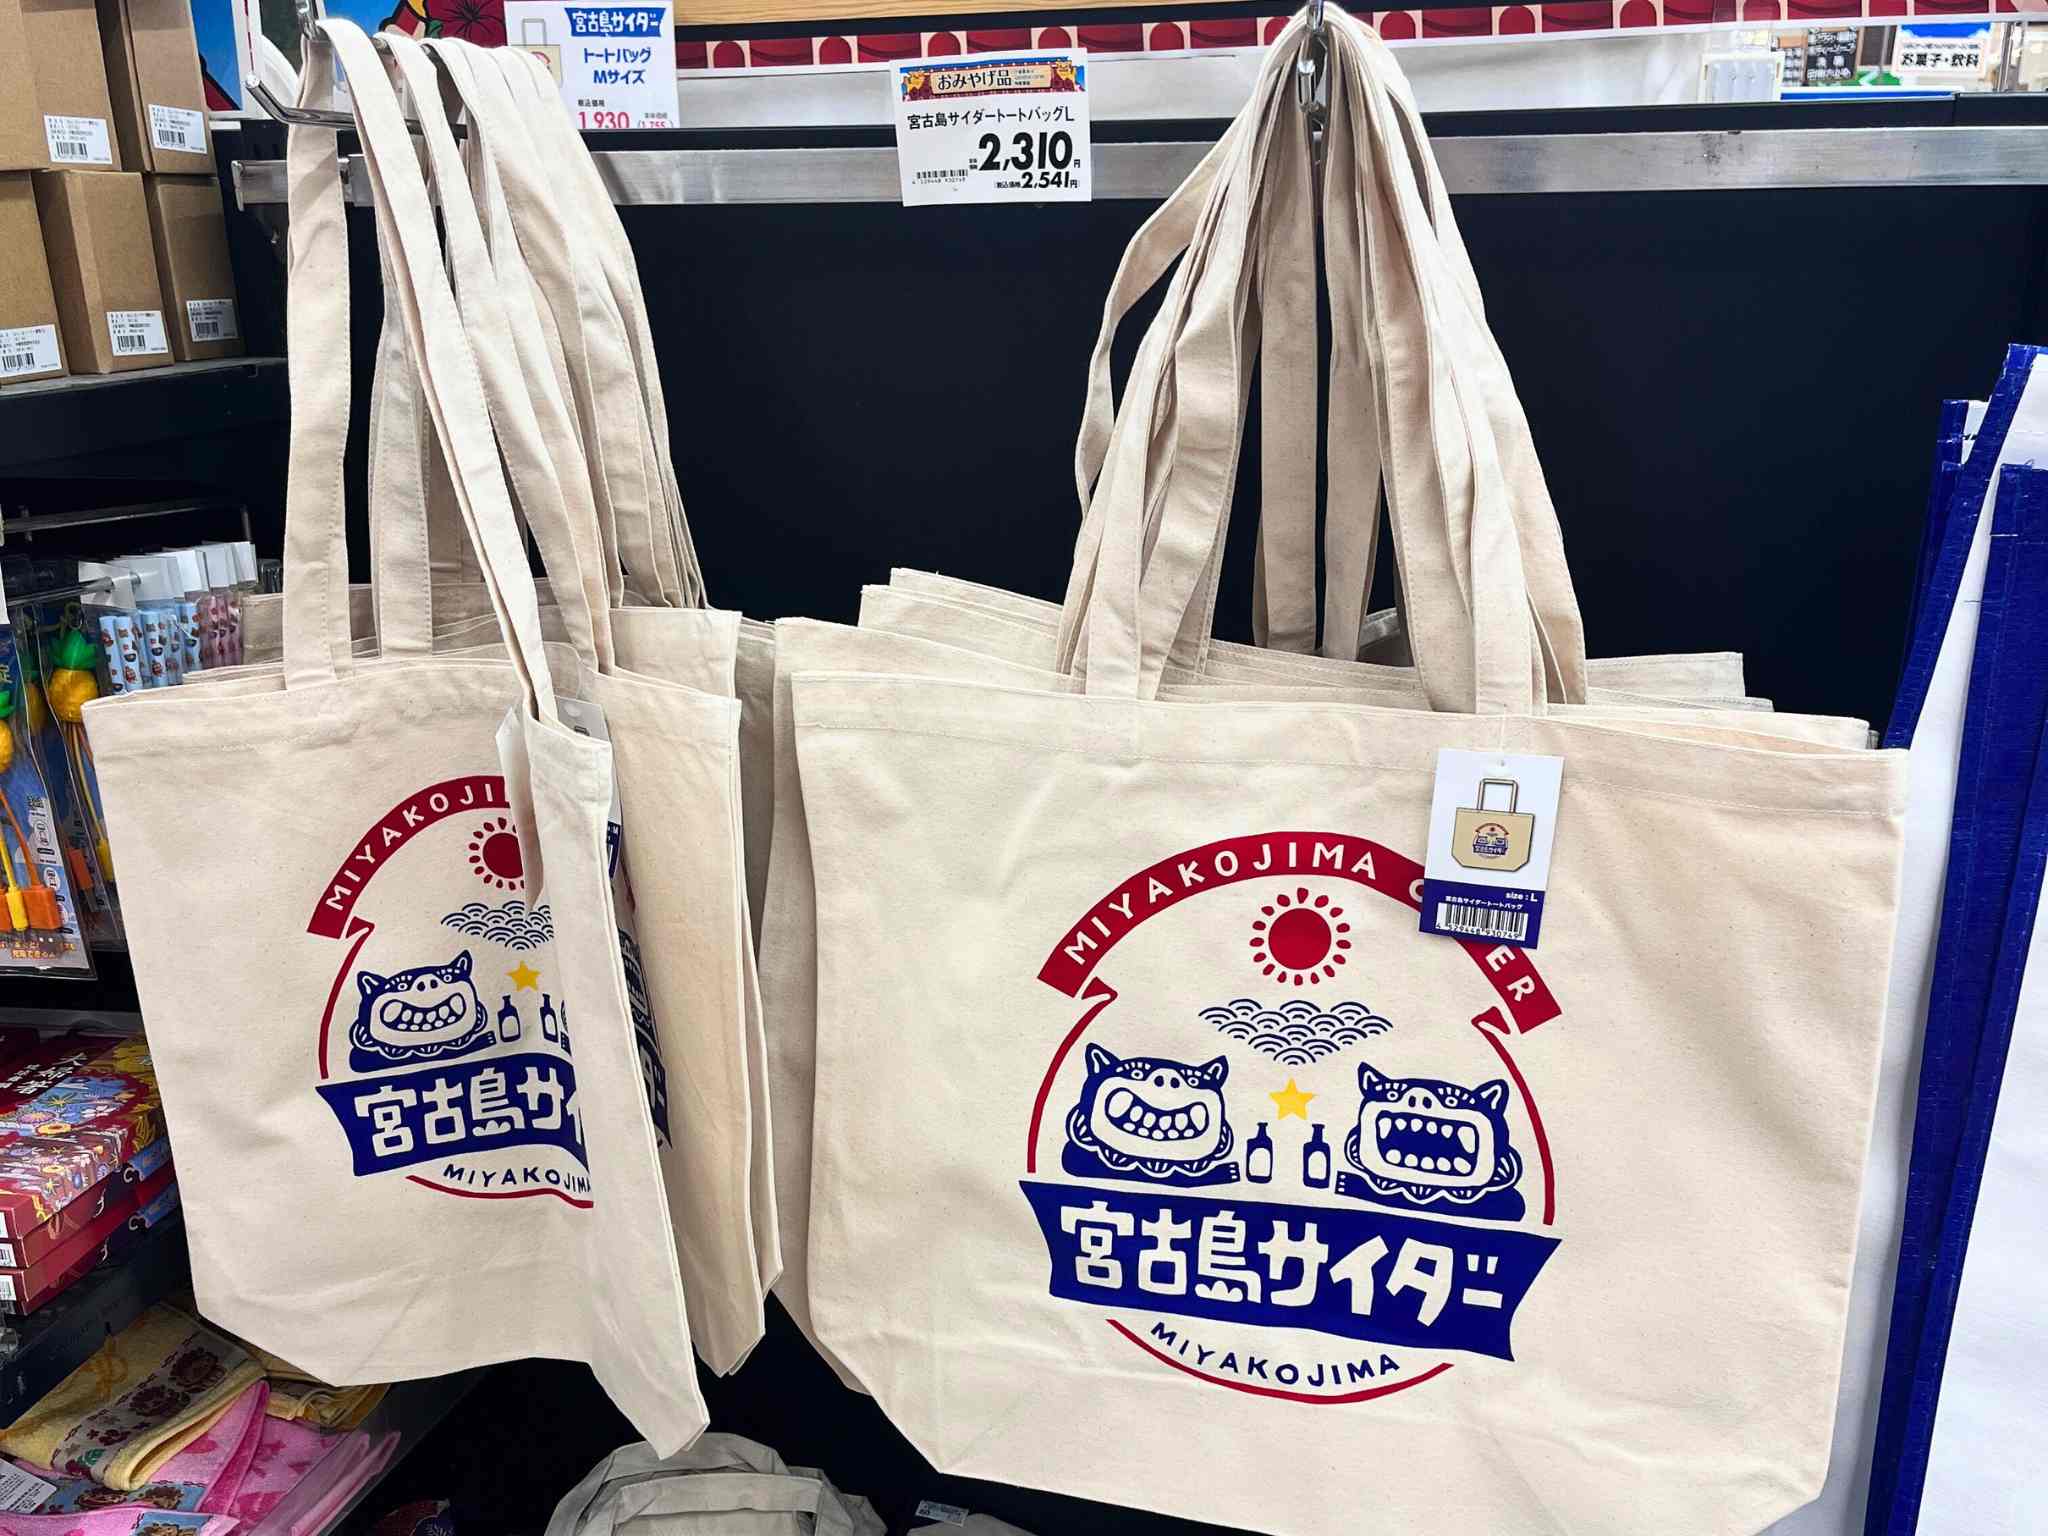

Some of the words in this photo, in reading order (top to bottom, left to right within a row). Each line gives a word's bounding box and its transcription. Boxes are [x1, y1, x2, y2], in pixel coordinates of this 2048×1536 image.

[572, 10, 658, 33] 宮古島サイダー
[584, 47, 651, 63] トートバッグ
[593, 69, 645, 84] Mサイズ
[937, 70, 1012, 91] おみやげ品
[578, 111, 630, 128] 1930
[907, 106, 1075, 130] 宮古島サイダートートバッグL
[326, 782, 510, 911] MIYAKOJI
[1064, 842, 1376, 967] MIYAKOJIMA
[1060, 1200, 1504, 1328] 宮古島サイダー
[1150, 1321, 1399, 1387] MIYAKOJIMA
